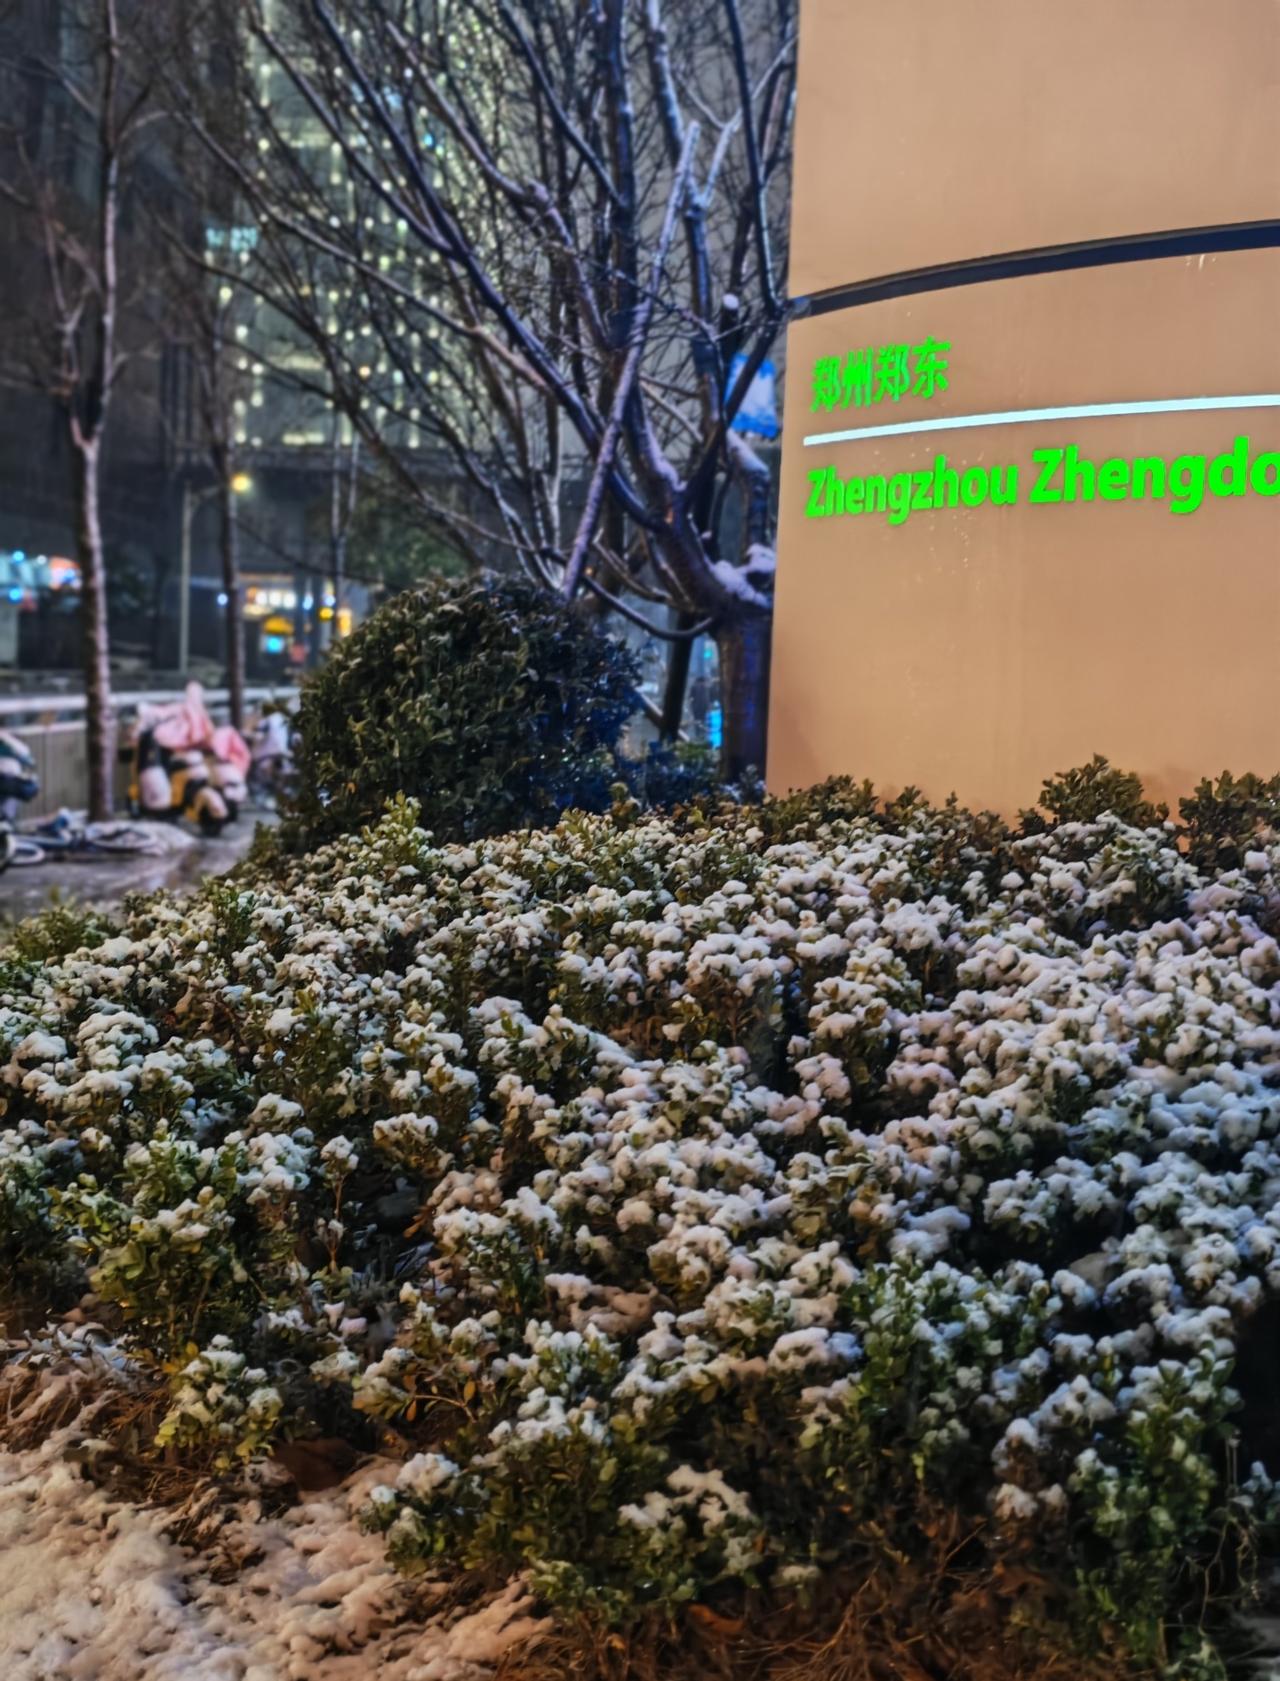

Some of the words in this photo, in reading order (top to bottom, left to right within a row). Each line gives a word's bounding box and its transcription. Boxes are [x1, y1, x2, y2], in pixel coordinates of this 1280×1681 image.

[810, 335, 952, 412] 郑州郑东
[804, 454, 1018, 525] Zhengzhou
[1028, 435, 1280, 513] Zhengdo
